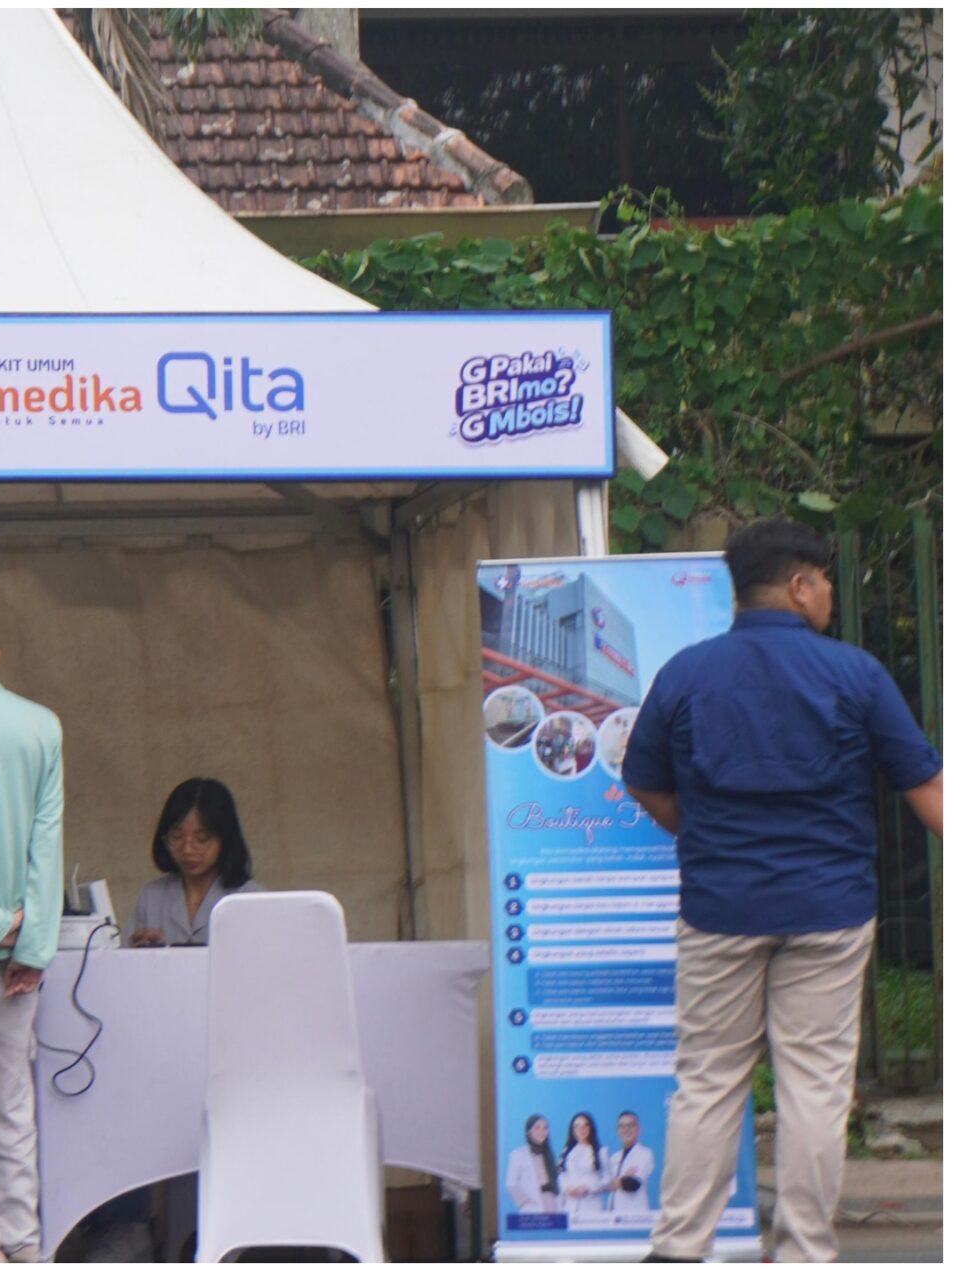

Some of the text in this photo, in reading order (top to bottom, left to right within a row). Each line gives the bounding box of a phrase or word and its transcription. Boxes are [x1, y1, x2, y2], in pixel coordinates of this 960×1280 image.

[27, 359, 75, 372] UMUM
[462, 351, 552, 384] G Pakai
[157, 352, 304, 420] Qita
[462, 368, 572, 412] BRImo?
[48, 416, 104, 426] Semua
[253, 420, 305, 439] by BRI
[462, 395, 581, 439] G Mbois!
